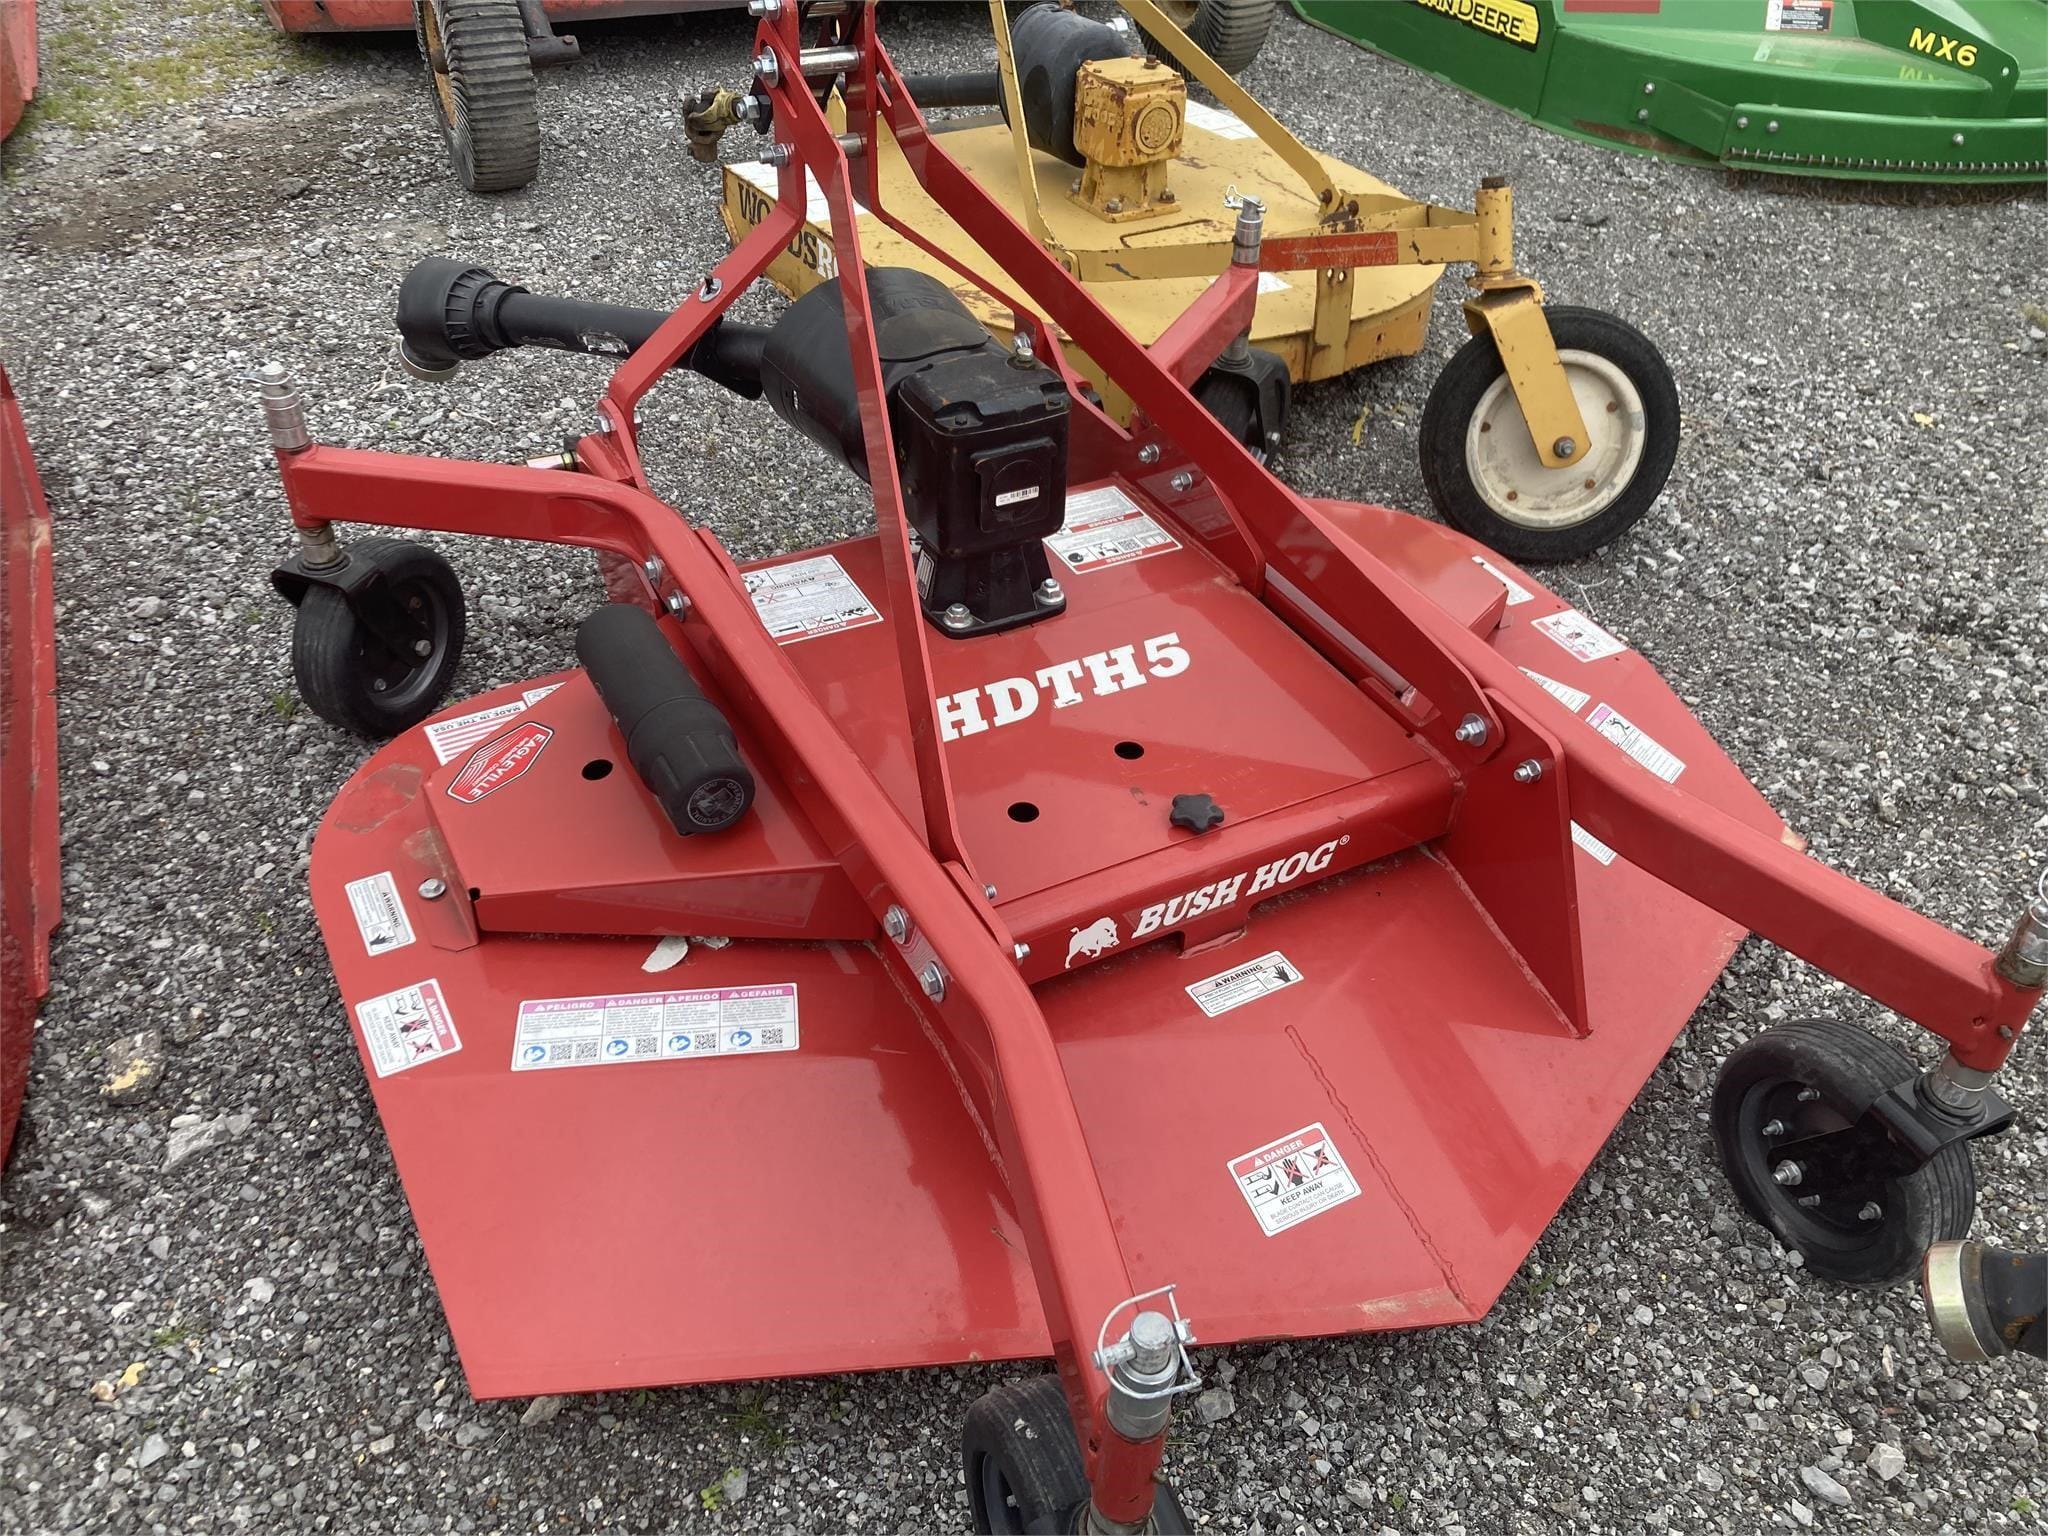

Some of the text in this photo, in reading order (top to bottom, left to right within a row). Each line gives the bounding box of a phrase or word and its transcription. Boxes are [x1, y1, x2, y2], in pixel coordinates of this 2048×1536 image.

[1908, 27, 1979, 68] MX6
[936, 632, 1190, 742] HDTH5
[493, 705, 521, 717] MADE
[432, 723, 454, 733] USA
[458, 718, 476, 727] THE
[468, 733, 546, 797] EAGLEVILLE
[383, 896, 401, 928] WARNING
[1131, 872, 1247, 939] BUSH
[1222, 964, 1263, 984] WARNING
[618, 997, 663, 1006] DANGER
[678, 993, 719, 1002] PERIGO
[741, 989, 783, 998] GEFAHR
[546, 1002, 594, 1011] PELIGRO
[428, 1004, 448, 1036] DANGER
[1263, 1139, 1304, 1162] DANGER
[1280, 1180, 1324, 1206] KEEP AWAY
[1288, 1196, 1312, 1211] CONTACT
[1312, 1190, 1326, 1201] CAN
[1275, 1210, 1300, 1224] SERIOUS
[1300, 1201, 1319, 1215] INJURY
[1325, 1188, 1345, 1201] DEATH
